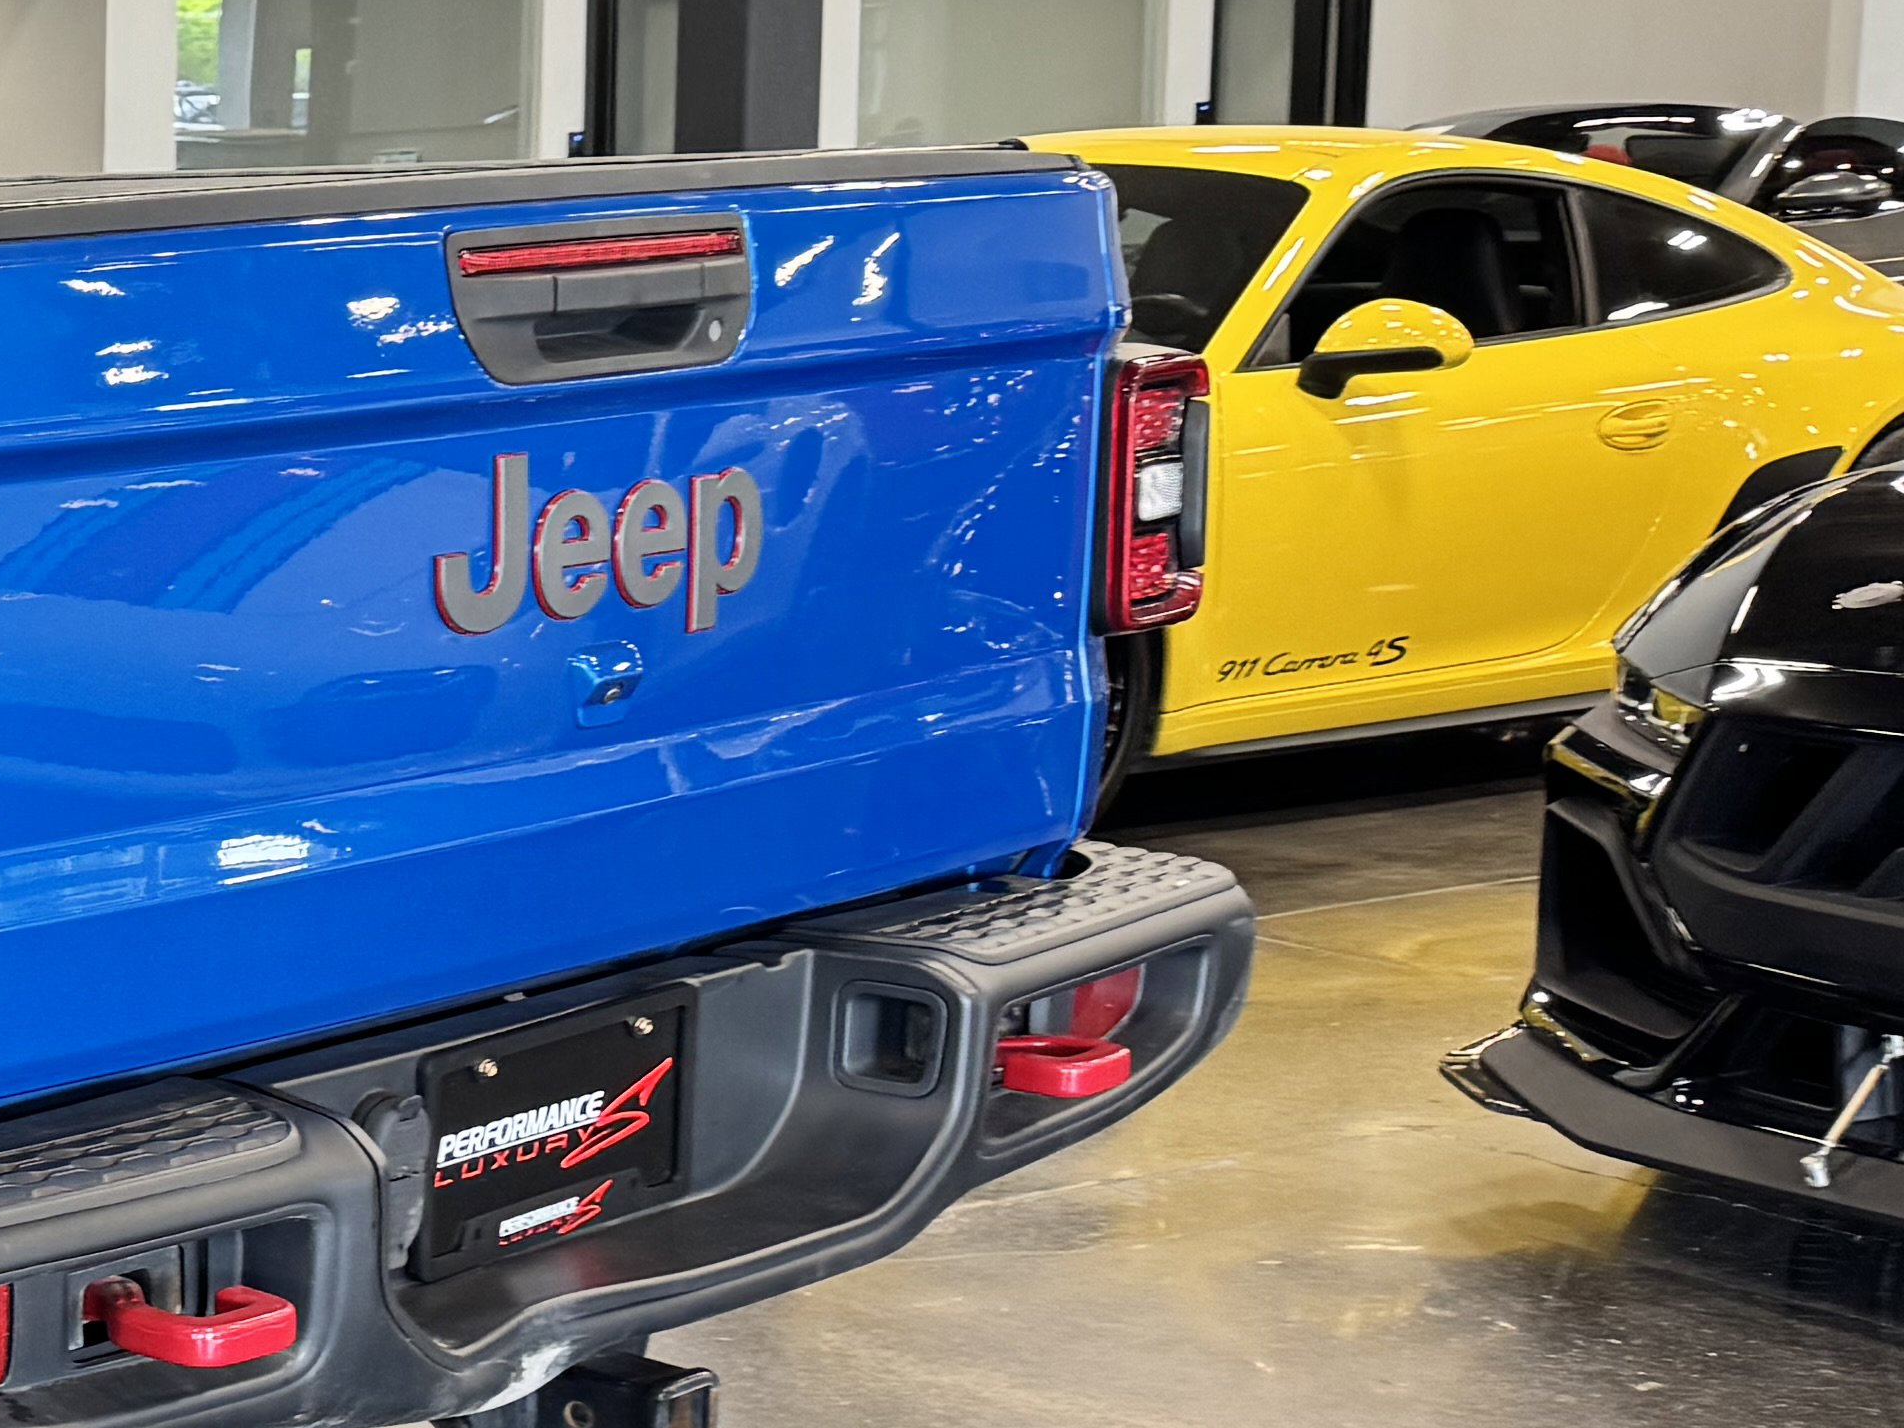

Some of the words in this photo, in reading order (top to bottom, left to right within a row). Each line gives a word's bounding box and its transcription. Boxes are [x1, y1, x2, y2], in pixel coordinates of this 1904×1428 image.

[433, 451, 763, 636] Jeep
[1216, 656, 1262, 683] 911
[1263, 651, 1359, 676] Carrera
[1365, 635, 1410, 667] 4S
[433, 1124, 597, 1188] LUXURY
[436, 1090, 606, 1164] PERFORMANCE
